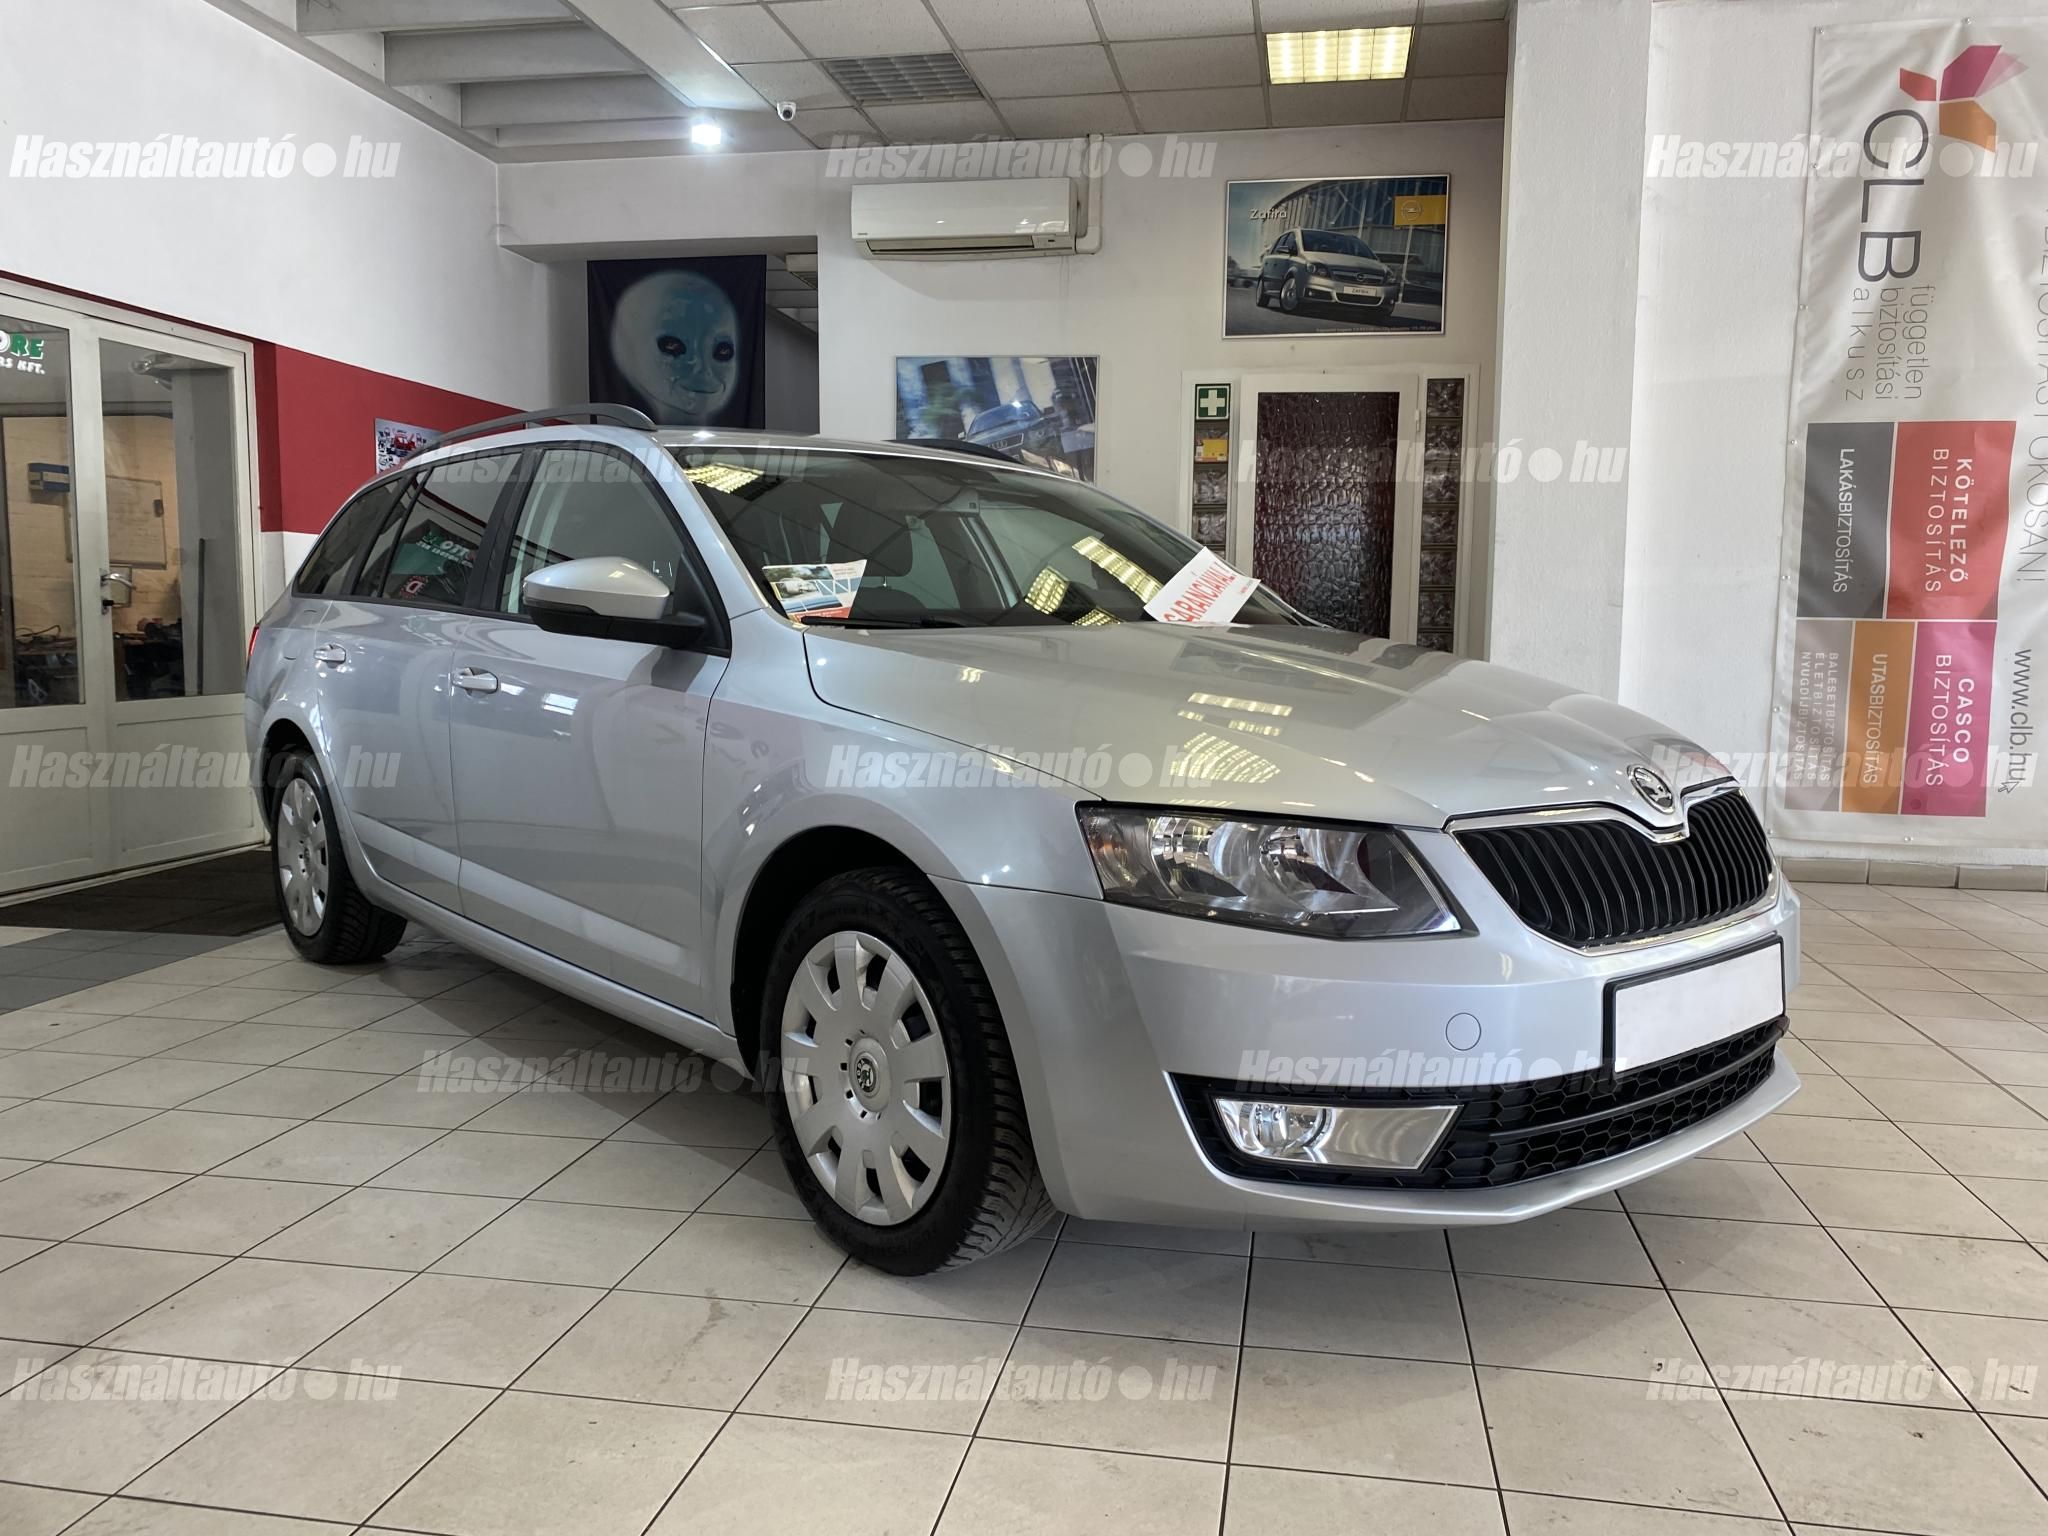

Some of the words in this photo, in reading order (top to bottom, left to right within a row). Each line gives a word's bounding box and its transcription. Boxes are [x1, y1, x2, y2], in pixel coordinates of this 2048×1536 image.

[1858, 109, 1929, 283] CLB
[1875, 287, 1904, 400] biztosítási
[1903, 284, 1936, 400] független
[1832, 448, 1857, 593] LAKÁSBIZTOSÍTÁS
[1925, 448, 1950, 592] BIZTOSÍTÁS
[1950, 458, 1975, 582] KÖTELEZŐ
[1863, 653, 1889, 784] UTASBIZTOSÍTÁS
[1925, 655, 1953, 786] BIZTOSÍTÁS
[1953, 679, 1975, 763] CASCO
[2008, 649, 2033, 781] www.clb.hu
